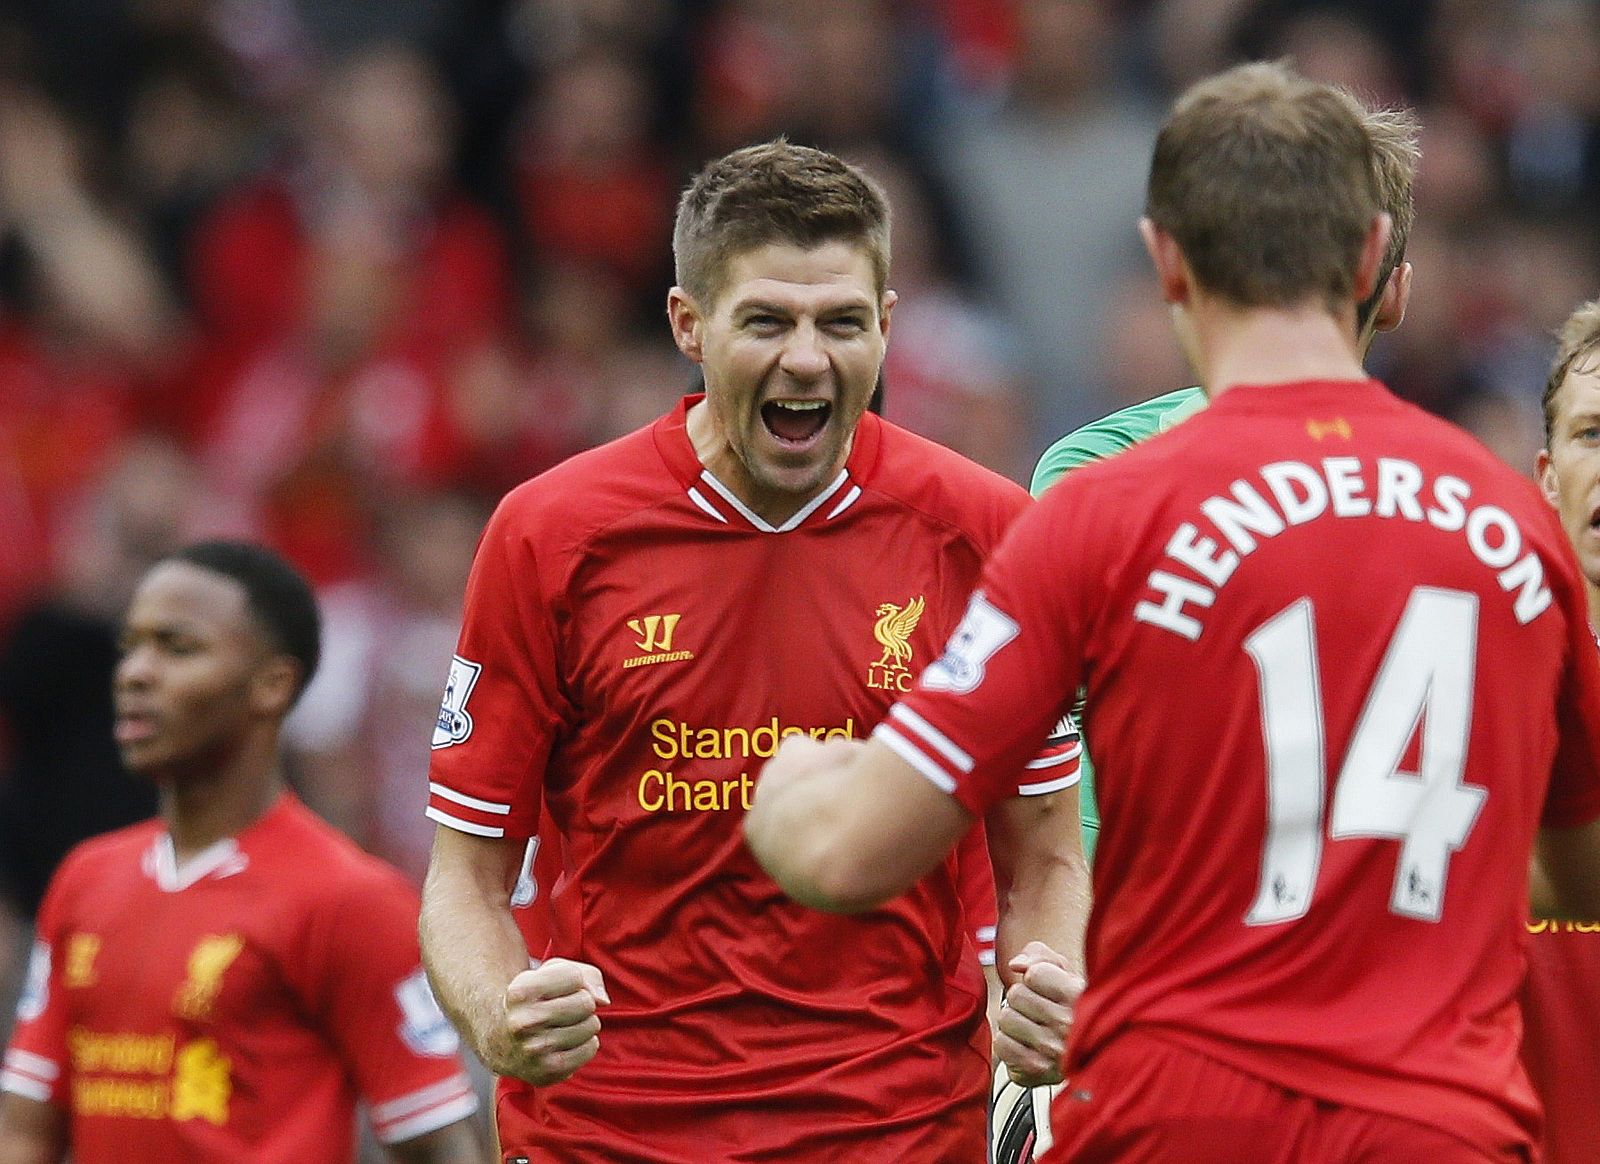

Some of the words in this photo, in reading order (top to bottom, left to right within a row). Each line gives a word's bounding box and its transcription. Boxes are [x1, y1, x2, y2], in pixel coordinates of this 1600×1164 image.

[1134, 456, 1554, 641] HENDERSON
[623, 650, 691, 669] WARRIOR
[638, 769, 754, 812] Chart
[1243, 586, 1489, 926] 14
